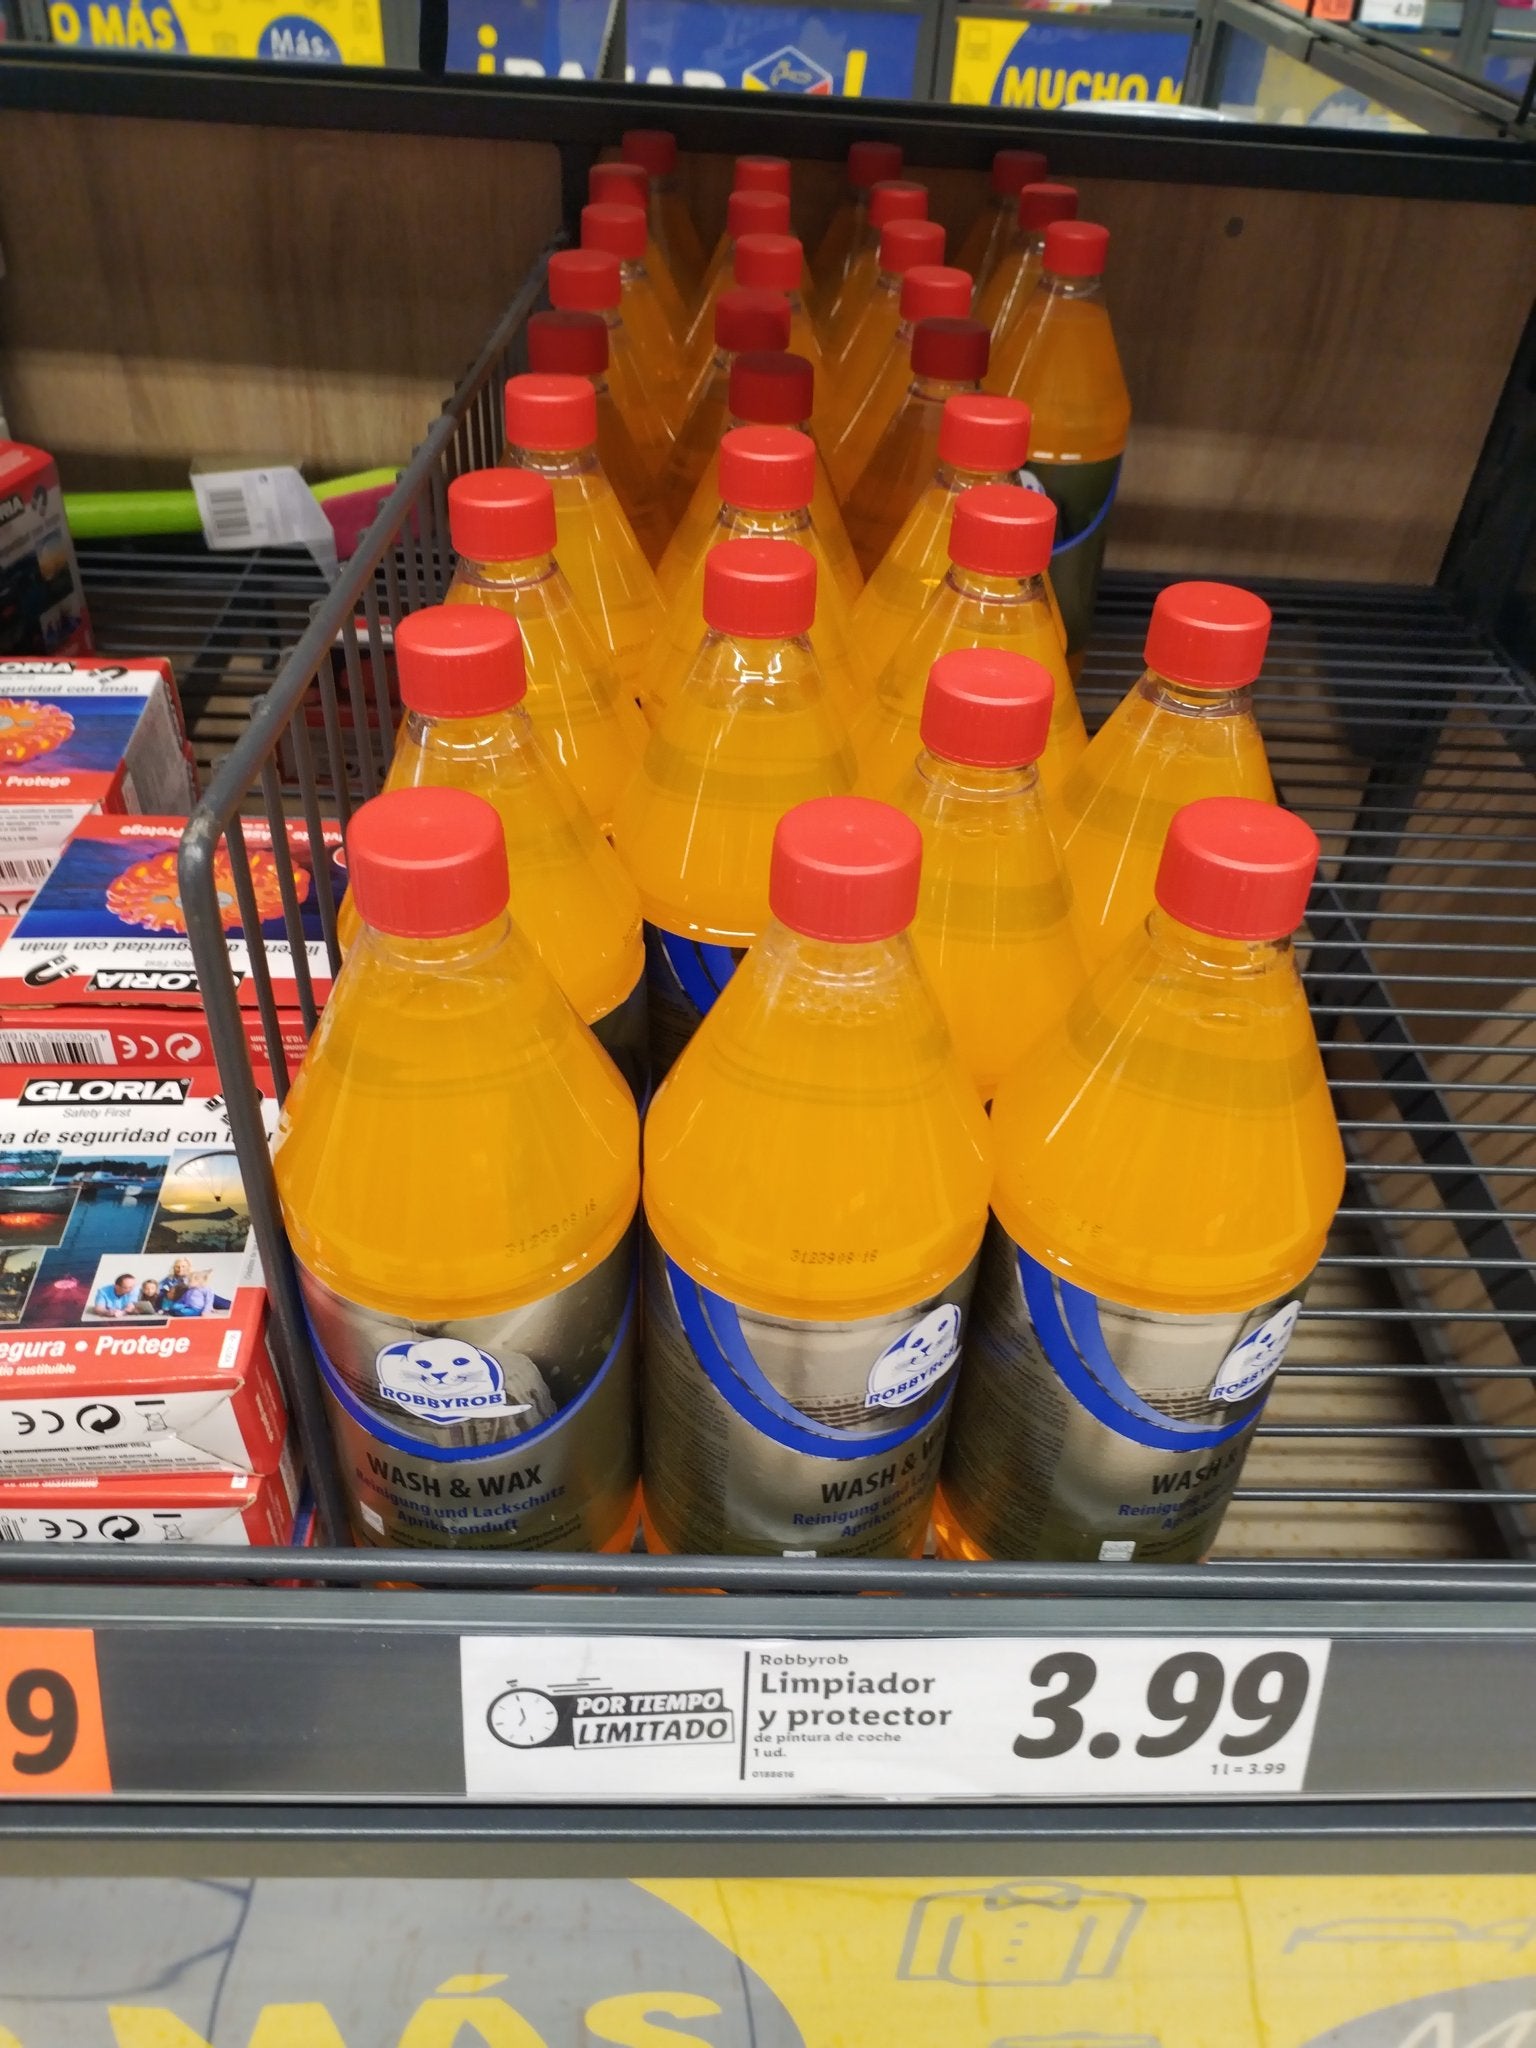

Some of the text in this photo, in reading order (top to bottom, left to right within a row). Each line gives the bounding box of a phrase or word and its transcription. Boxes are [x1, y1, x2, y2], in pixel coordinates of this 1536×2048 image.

[1002, 65, 1149, 110] MUCHO
[24, 1080, 184, 1101] GLORIA
[63, 1107, 131, 1119] Safety First
[23, 1129, 50, 1144] de
[57, 1128, 170, 1147] seguridad
[178, 1131, 217, 1143] con
[95, 1335, 190, 1358] Protege
[382, 1386, 503, 1409] ROBBYROB
[367, 1451, 542, 1498] WASH & WAX
[821, 1464, 896, 1504] WASH
[1152, 1458, 1222, 1495] WASH
[356, 1467, 566, 1519] Reinigung und Lackschutz
[397, 1510, 519, 1535] Aprikosenduft
[793, 1501, 880, 1526] Reinigung
[760, 1654, 849, 1667] Robbyrob
[761, 1671, 936, 1699] Limpiador
[576, 1691, 722, 1715] POR TIEMPO
[1012, 1650, 1311, 1760] 3.99
[6, 1668, 78, 1775] 9
[758, 1707, 953, 1731] y protector
[578, 1718, 728, 1746] LIMITADO
[753, 1731, 902, 1744] de pintura de coche
[754, 1747, 787, 1757] 1 ud.
[1248, 1763, 1286, 1775] 3.99
